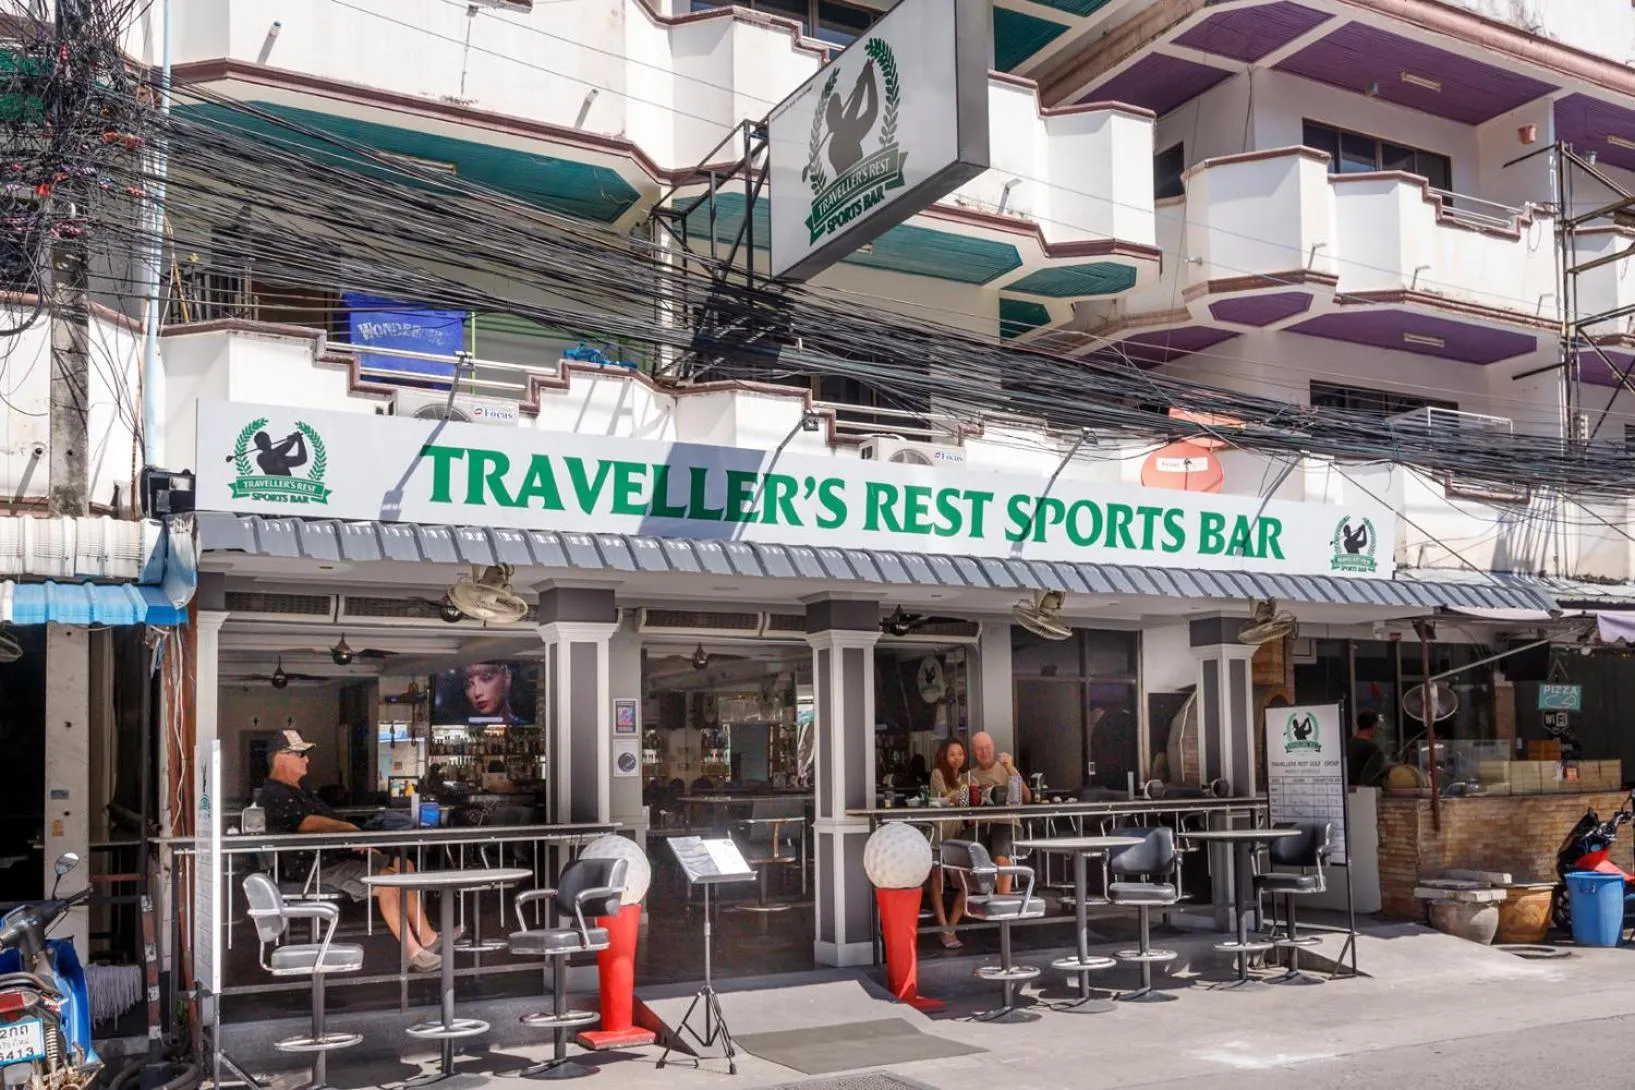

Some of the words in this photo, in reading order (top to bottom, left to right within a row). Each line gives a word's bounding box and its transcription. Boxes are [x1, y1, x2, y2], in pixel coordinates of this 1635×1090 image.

[818, 168, 868, 217] TRAVELLER'S
[869, 157, 890, 177] REST
[826, 199, 862, 234] SPORTS
[863, 185, 885, 211] BAR
[244, 480, 297, 490] TRAVELLER'S
[297, 482, 316, 493] REST
[252, 492, 288, 503] SPORTS
[290, 494, 310, 504] BAR
[419, 443, 848, 529] TRAVELLER'S
[862, 481, 995, 538] REST
[1004, 493, 1186, 553] SPORTS
[1197, 511, 1286, 560] BAR
[1543, 685, 1578, 695] PIZZA
